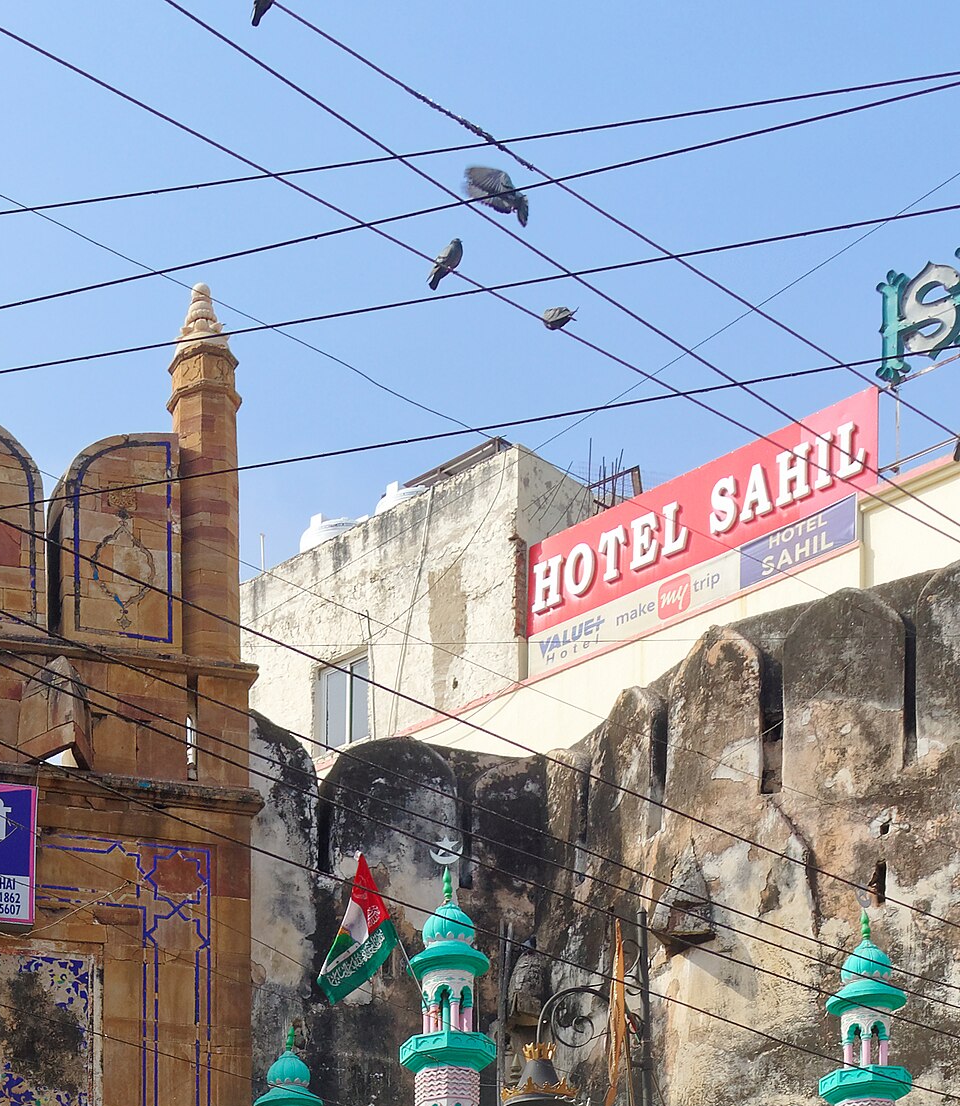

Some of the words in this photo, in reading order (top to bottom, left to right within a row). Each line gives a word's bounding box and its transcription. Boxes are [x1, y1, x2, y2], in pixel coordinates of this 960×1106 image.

[531, 501, 689, 615] HOTEL
[709, 421, 868, 535] SAHIL
[768, 514, 827, 549] HOTEL
[760, 535, 834, 577] SAHIL
[616, 600, 656, 627] make
[693, 572, 720, 594] trip
[545, 633, 600, 666] Hotel
